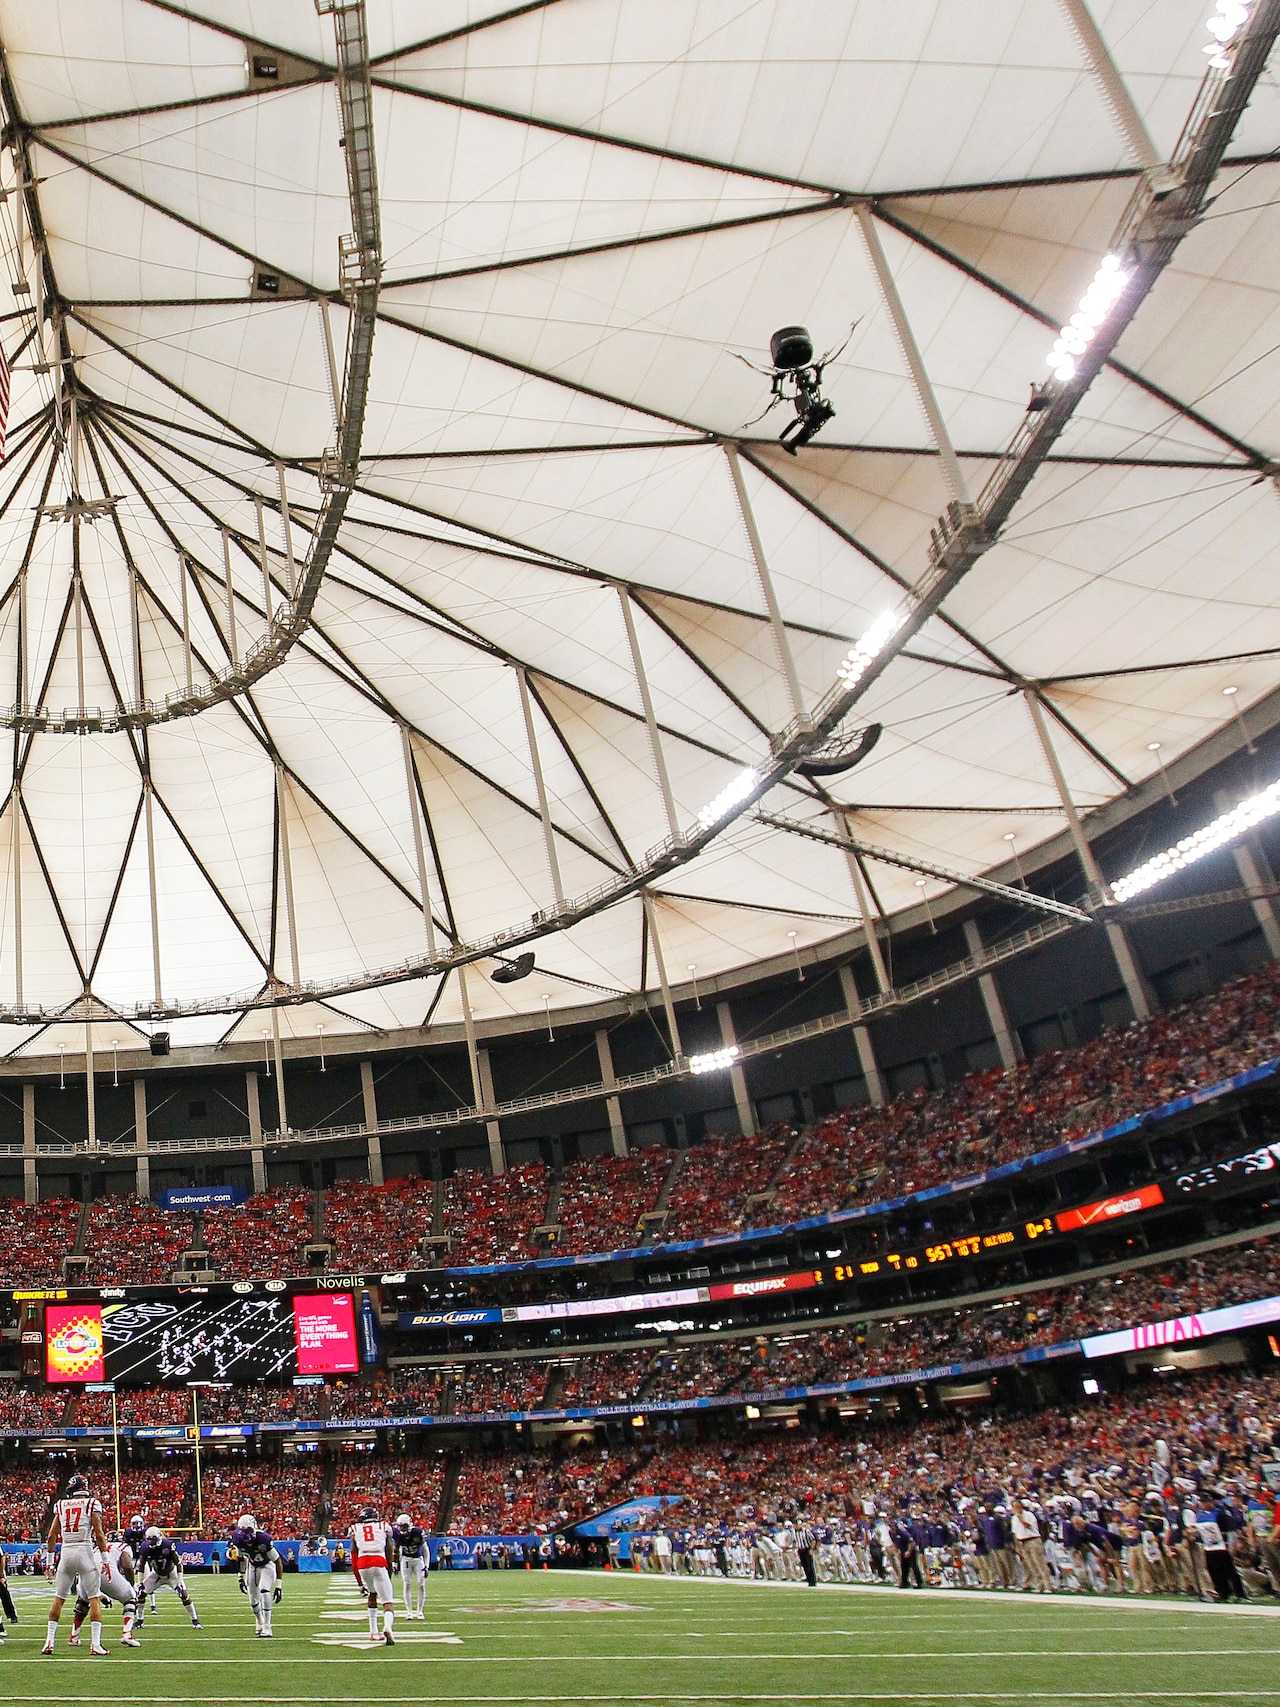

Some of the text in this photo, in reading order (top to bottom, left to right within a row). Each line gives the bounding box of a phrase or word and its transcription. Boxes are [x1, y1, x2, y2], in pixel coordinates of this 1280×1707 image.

[1104, 1197, 1142, 1216] verizon
[834, 1265, 854, 1281] 21
[926, 1243, 953, 1263] 5:57
[235, 1283, 250, 1292] KIA
[269, 1282, 283, 1290] KIA
[316, 1276, 366, 1289] Novelis
[733, 1278, 787, 1295] EQUIFAX
[12, 1291, 56, 1300] QUIKRETE
[412, 1312, 488, 1325] BUD LIGHT
[300, 1324, 337, 1333] THE MORE
[300, 1331, 348, 1341] EVERYTHING
[56, 1339, 96, 1348] LOTTERY
[301, 1340, 323, 1348] PLAN.
[597, 1401, 699, 1415] COLLEGE FOOTBALL PLAYOFF
[326, 1417, 423, 1428] COLLEGE FOOTBALL PLAYOFF
[210, 1426, 242, 1436] Aaron's
[65, 1508, 82, 1532] 17
[362, 1525, 375, 1542] 8
